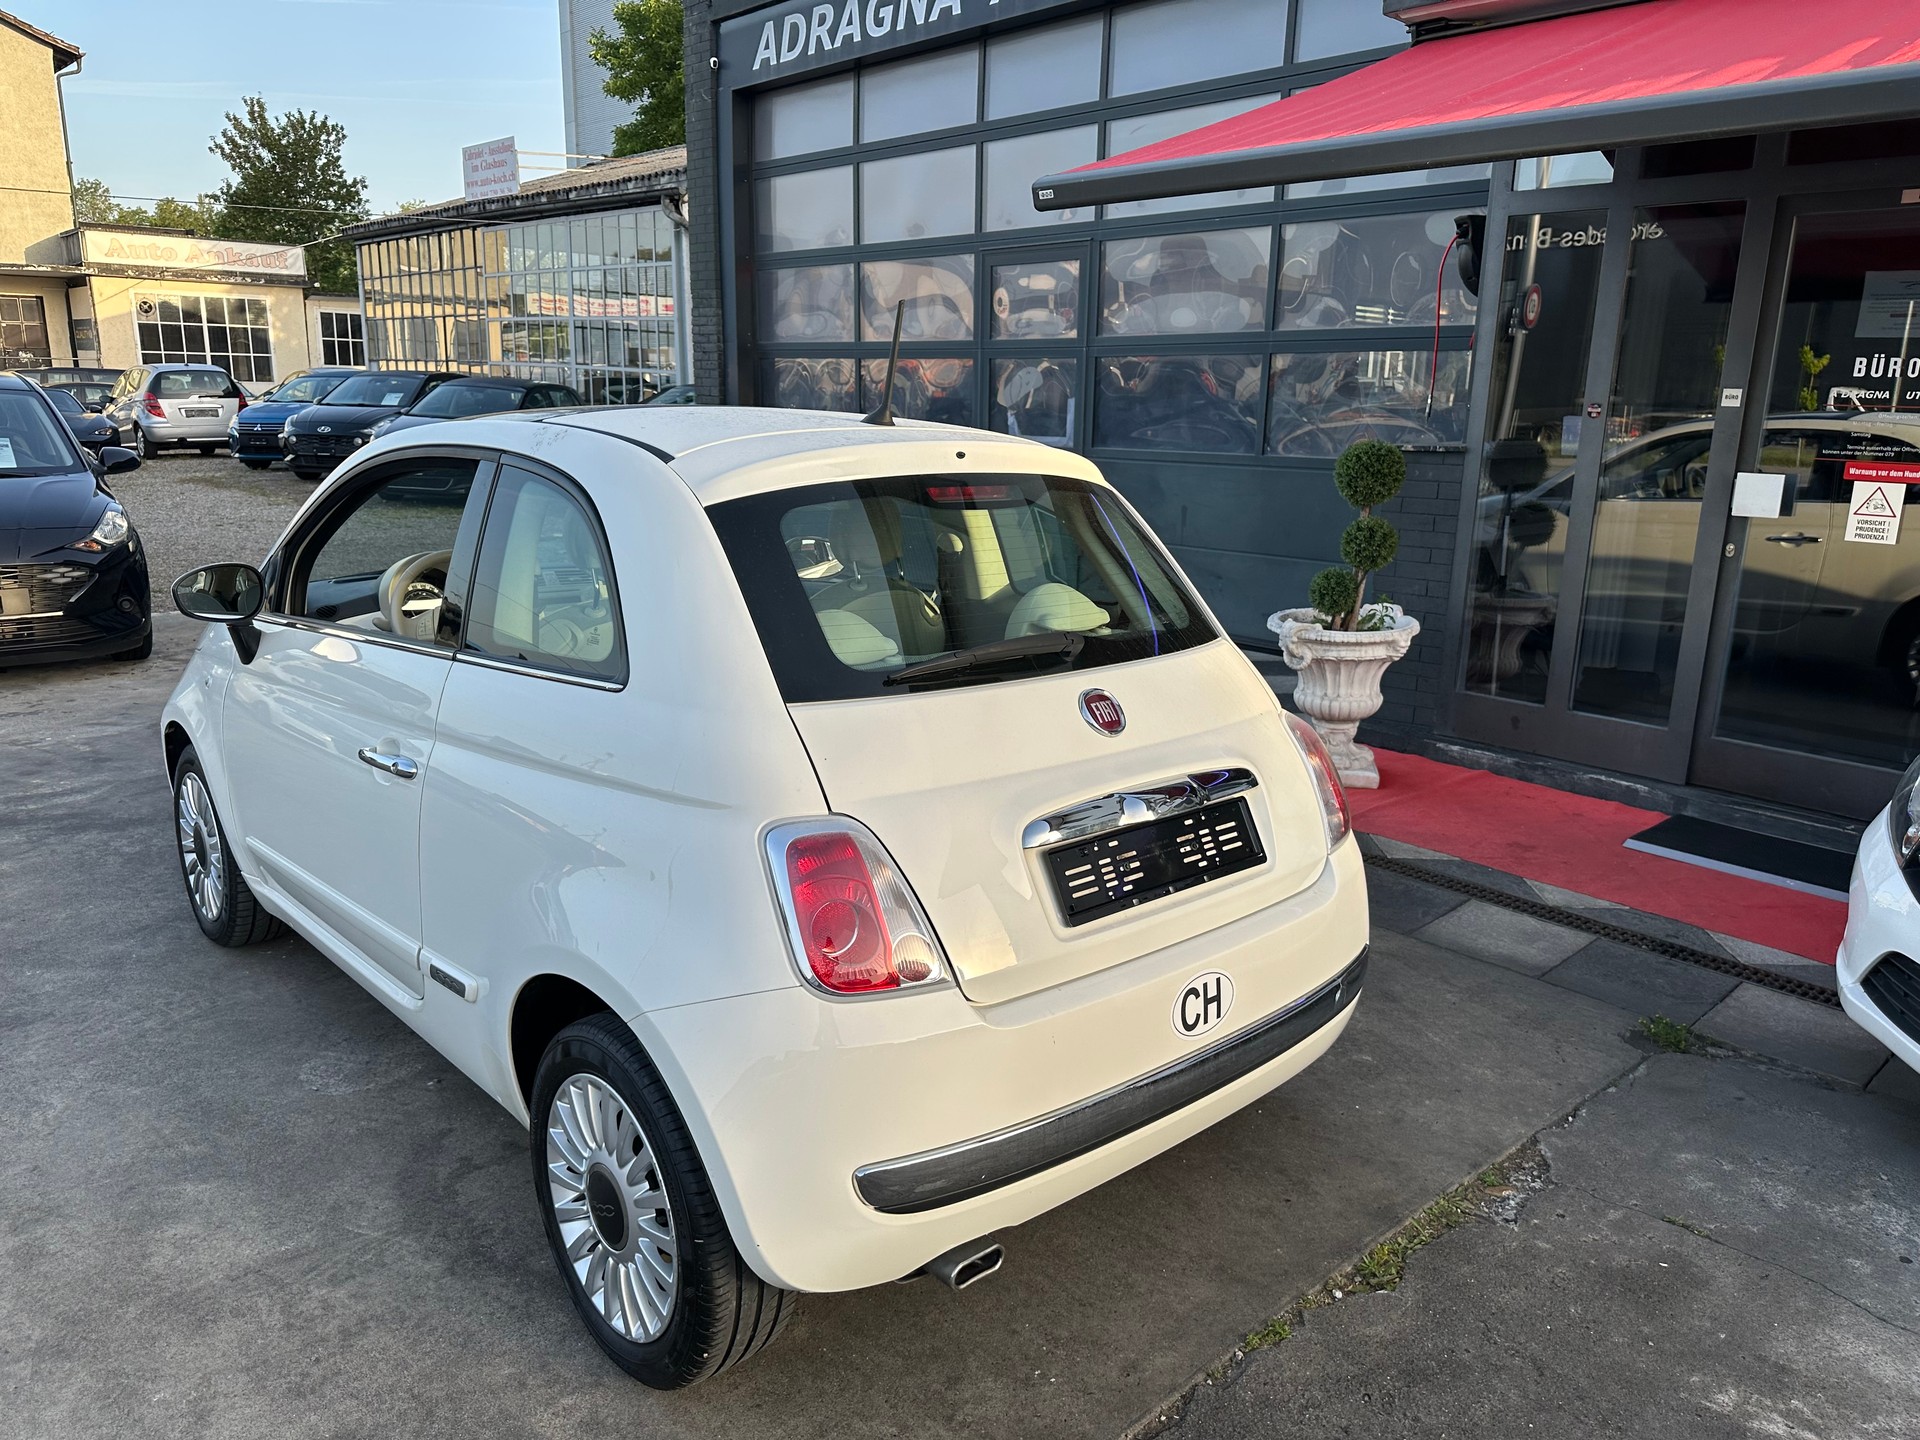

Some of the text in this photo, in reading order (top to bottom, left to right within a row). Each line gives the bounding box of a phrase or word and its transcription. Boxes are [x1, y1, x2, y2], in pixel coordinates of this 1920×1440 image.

[471, 158, 507, 173] im Glashaus
[466, 171, 516, 188] www.auto-koch.ch
[105, 238, 288, 269] Auto Ankauf
[1853, 353, 1920, 378] BÜRO
[1849, 467, 1876, 476] Warnung
[1856, 519, 1886, 527] VORSICHT
[1854, 532, 1884, 540] PRUDENZA
[1090, 700, 1118, 723] FIAT
[1181, 977, 1221, 1032] CH
